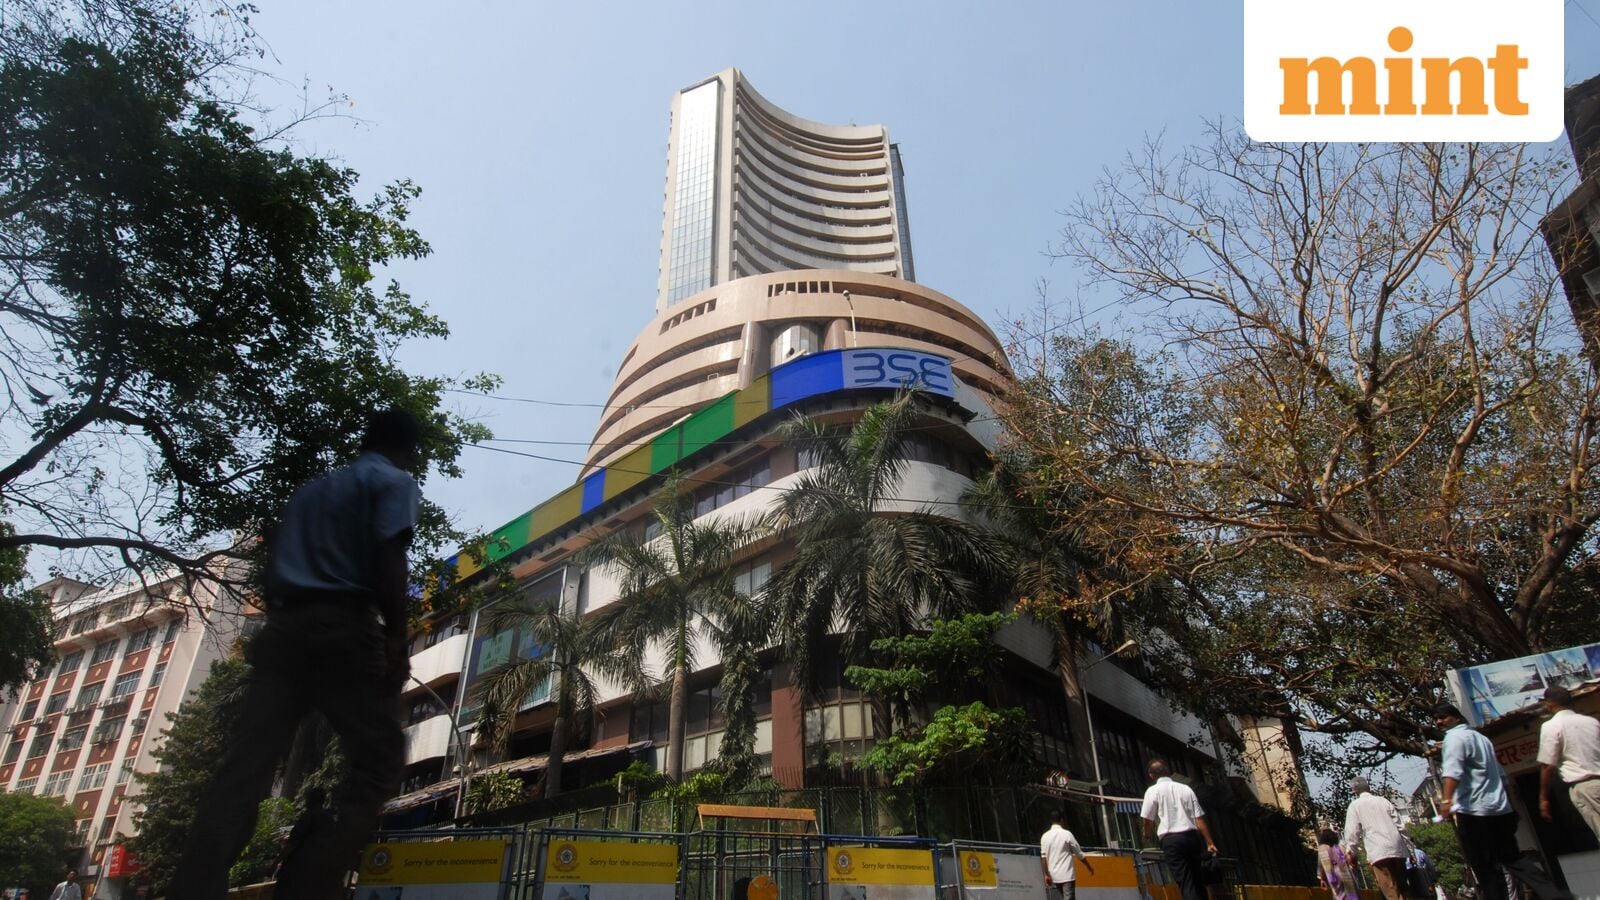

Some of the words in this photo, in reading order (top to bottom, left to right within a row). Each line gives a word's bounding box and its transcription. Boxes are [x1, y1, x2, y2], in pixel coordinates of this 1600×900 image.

[853, 352, 948, 391] BSE
[403, 858, 422, 868] Sorry
[423, 858, 434, 868] for
[436, 858, 448, 866] the
[449, 857, 498, 866] inconvenience
[589, 857, 606, 868] Sorry
[607, 857, 618, 867] for
[620, 858, 630, 867] the
[631, 859, 673, 868] inconvenience
[862, 861, 877, 871] Sorry
[877, 862, 885, 871] for
[886, 862, 895, 870] the
[895, 863, 930, 871] inconvenience
